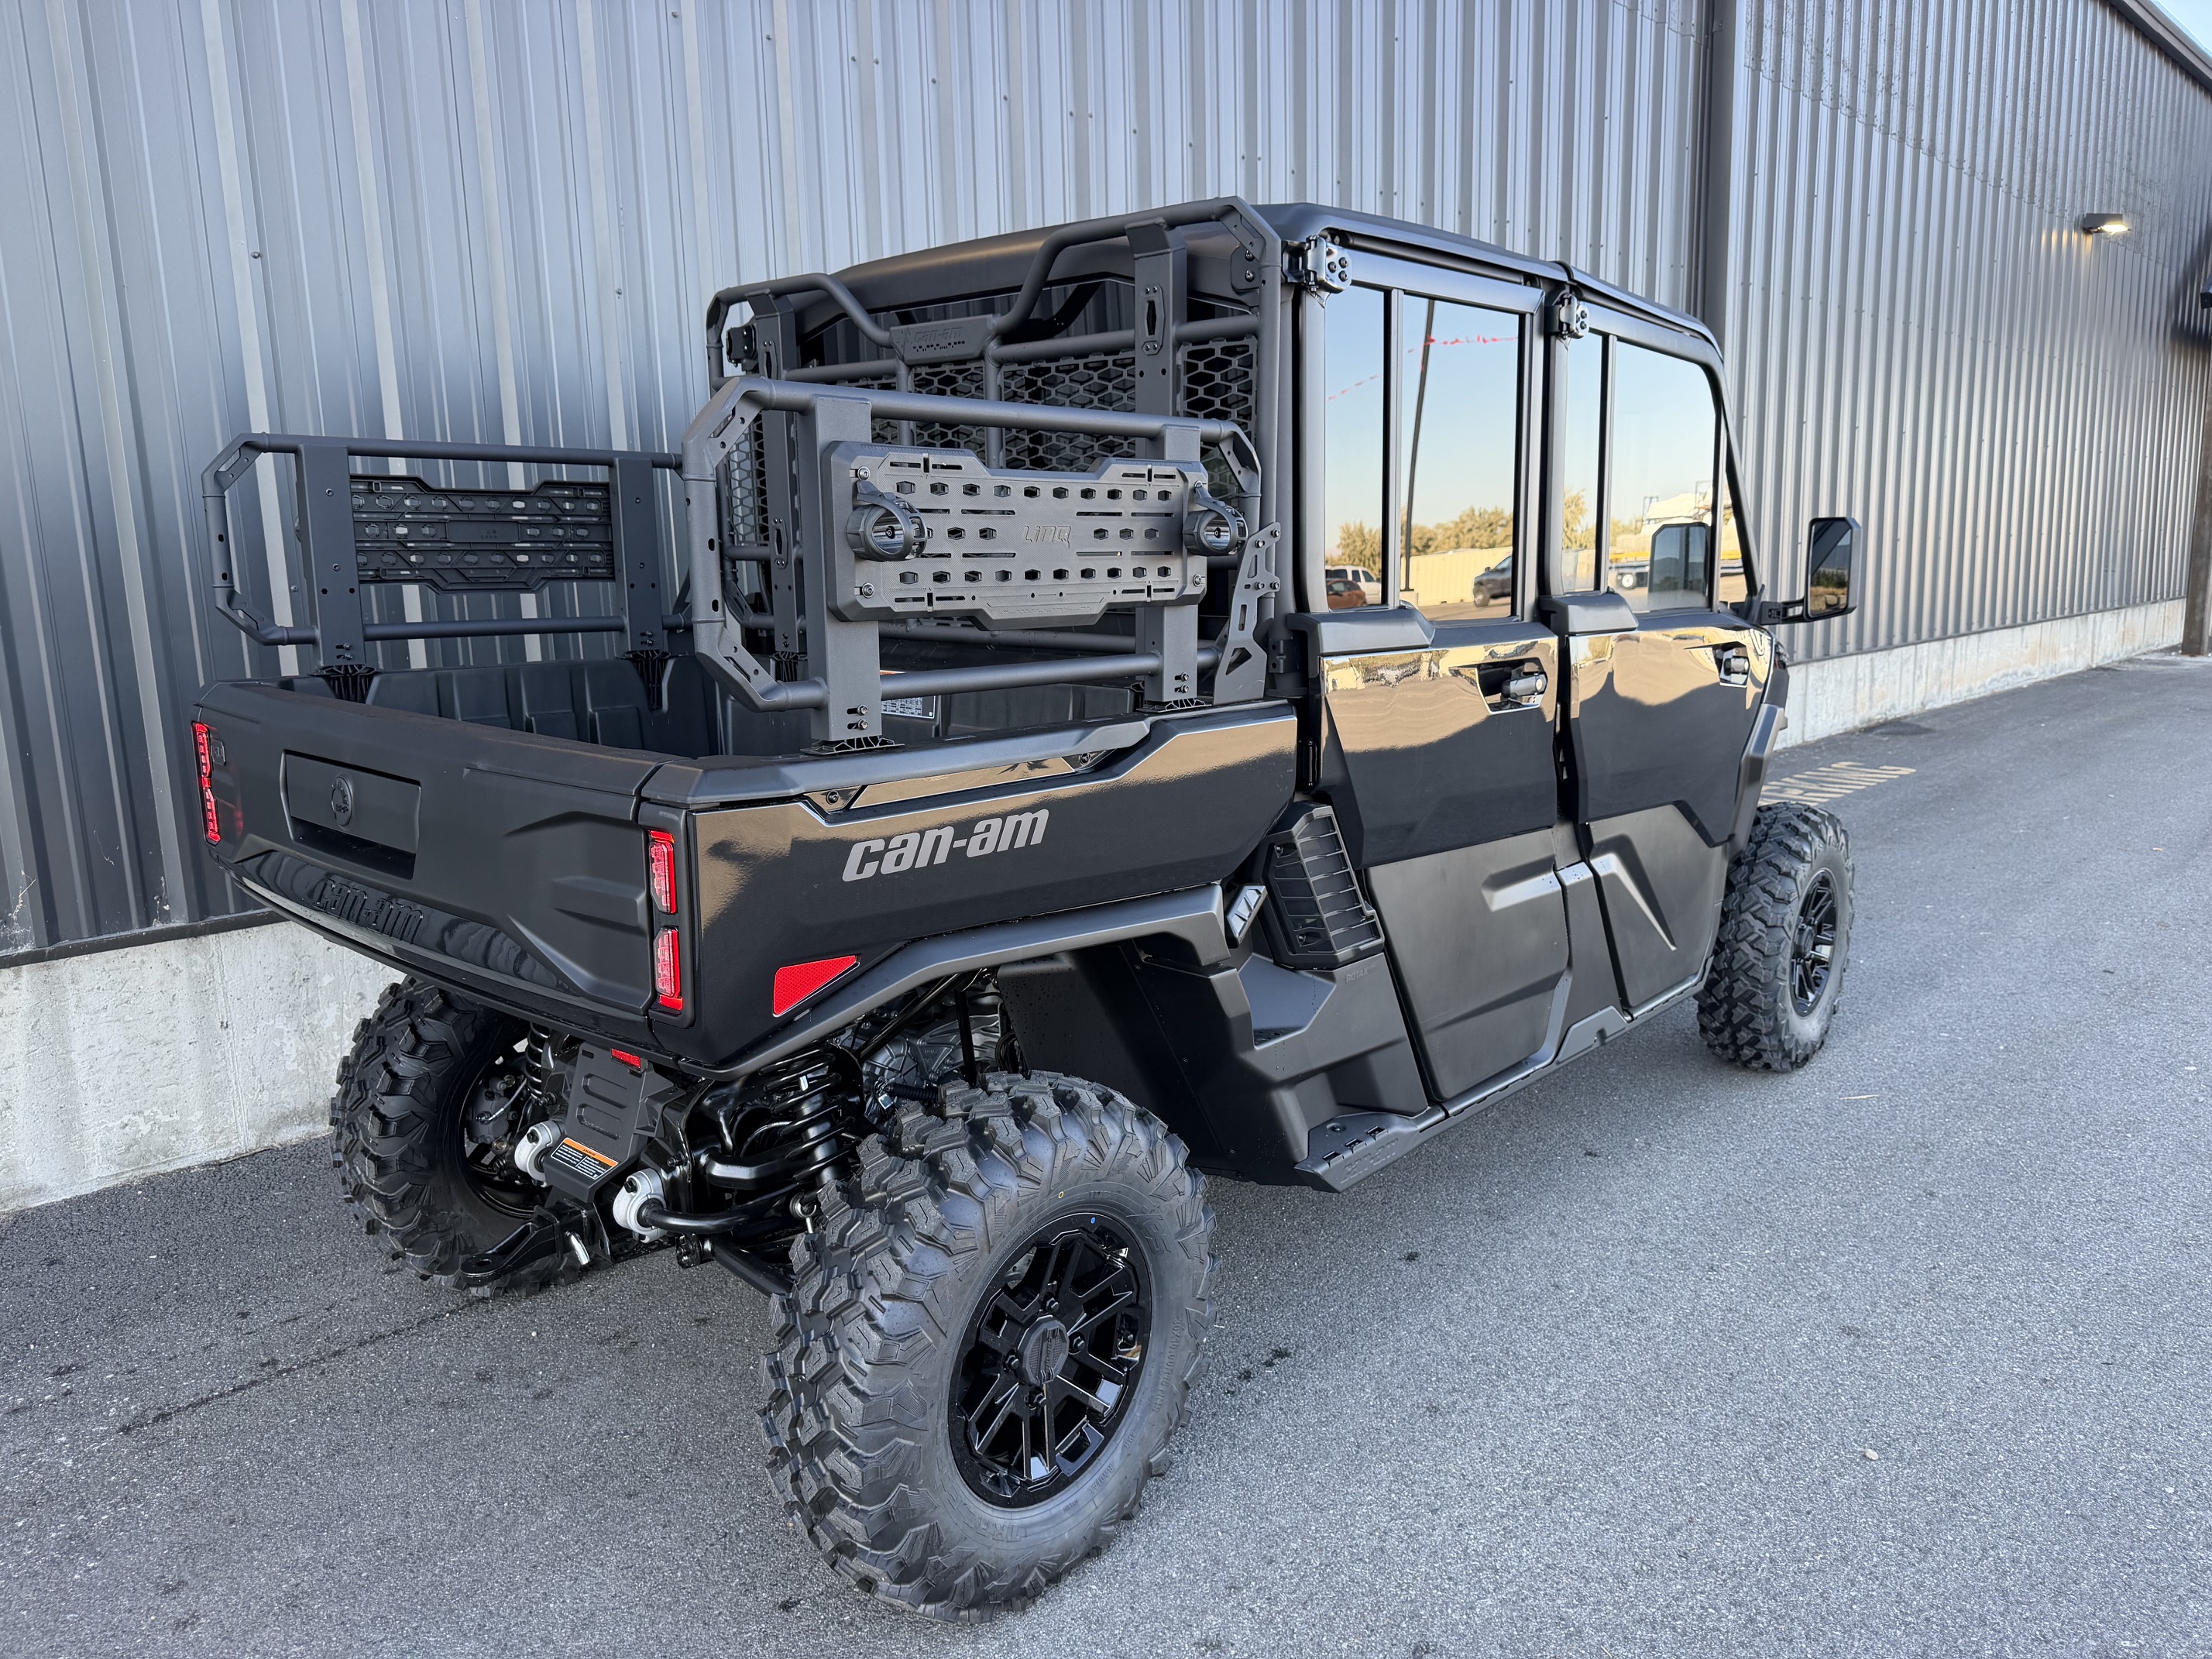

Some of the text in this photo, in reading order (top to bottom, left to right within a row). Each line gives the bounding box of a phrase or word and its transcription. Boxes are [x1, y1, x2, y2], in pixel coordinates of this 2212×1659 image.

[842, 809, 1049, 882] can-am
[313, 876, 424, 945] can-am
[1345, 966, 1369, 984] ROTAX
